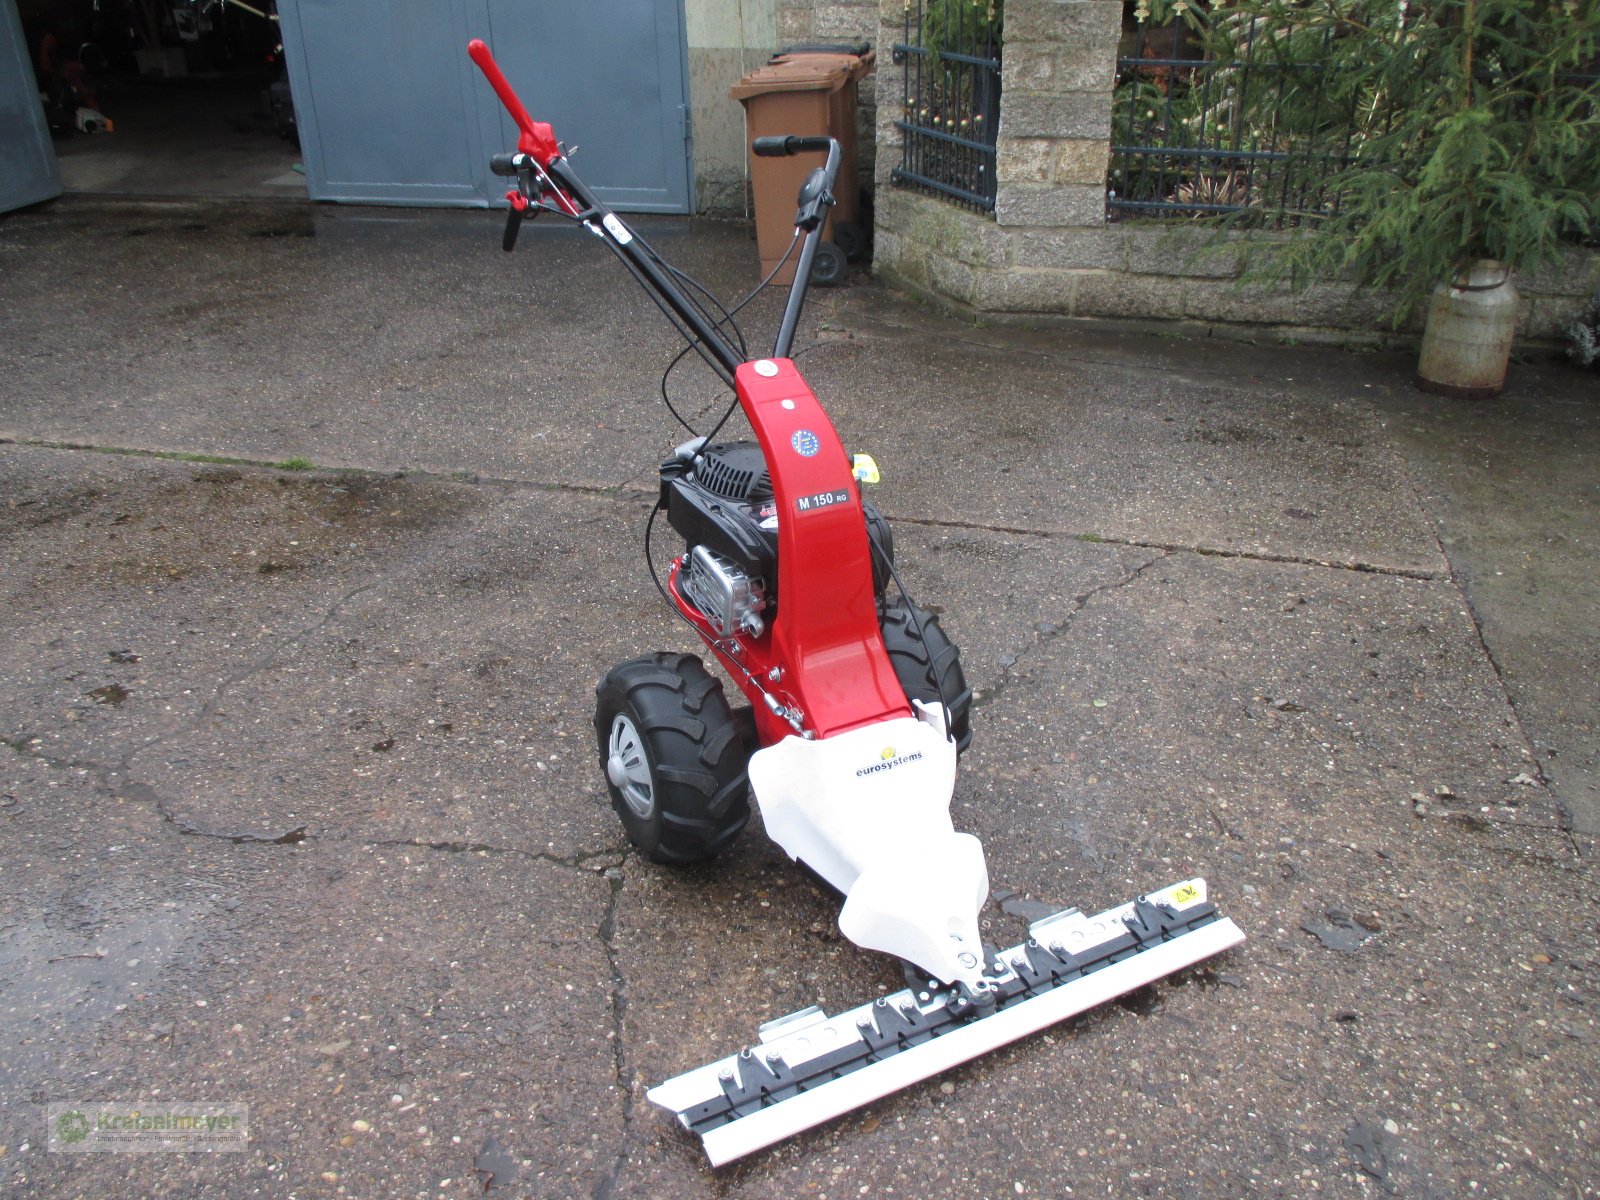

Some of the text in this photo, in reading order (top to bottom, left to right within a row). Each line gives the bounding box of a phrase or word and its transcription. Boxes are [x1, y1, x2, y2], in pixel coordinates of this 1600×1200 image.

[799, 493, 847, 510] M 150 RG
[856, 752, 923, 776] eurosystems
